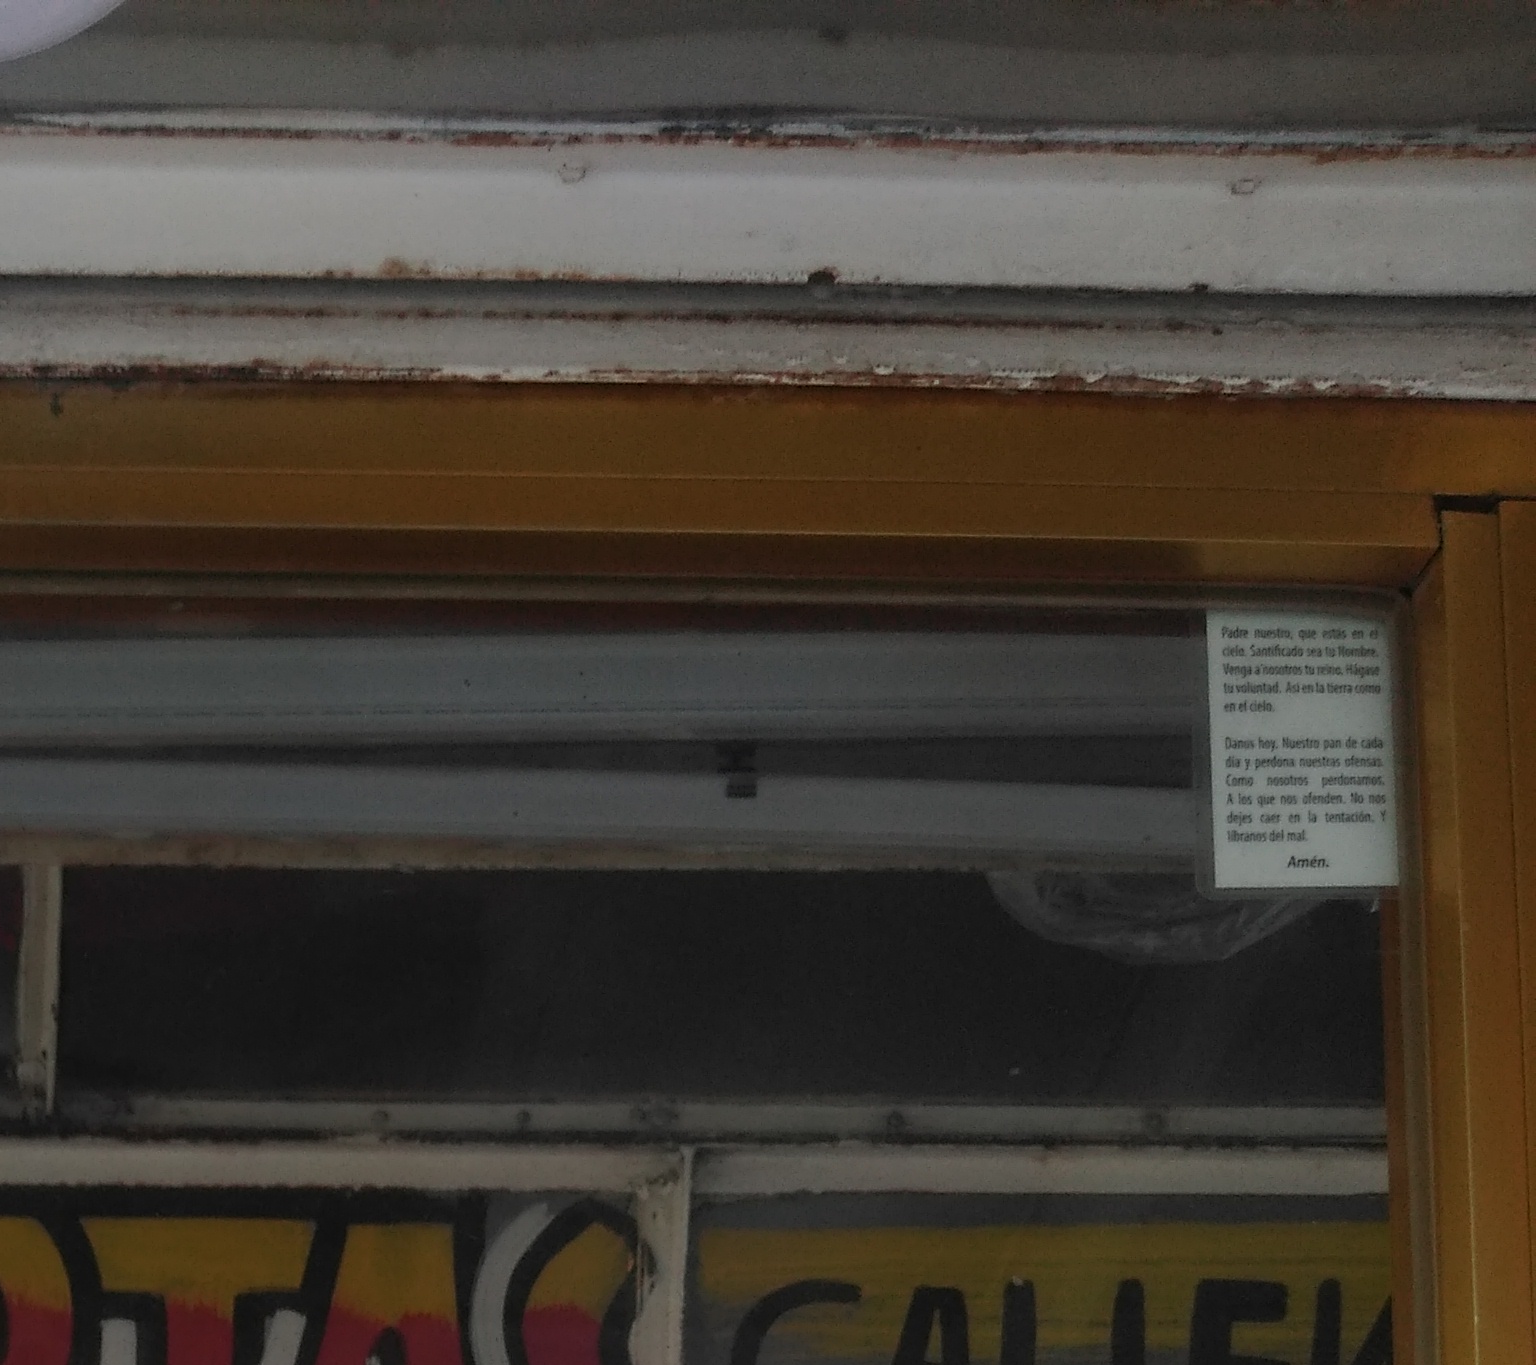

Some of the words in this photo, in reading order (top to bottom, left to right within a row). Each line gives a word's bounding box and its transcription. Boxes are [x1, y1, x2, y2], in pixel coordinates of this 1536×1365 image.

[1221, 626, 1249, 640] Padre
[1253, 627, 1294, 640] nuestro,
[1297, 629, 1317, 641] que
[1351, 629, 1364, 639] en
[1369, 628, 1379, 640] el
[1249, 644, 1304, 658] Santificado
[1305, 647, 1323, 657] sea
[1324, 646, 1336, 658] tu
[1222, 663, 1253, 678] Venga
[1261, 664, 1303, 676] nosotros
[1304, 664, 1316, 676] tu
[1316, 664, 1344, 676] reino.
[1223, 683, 1235, 694] tu
[1235, 681, 1282, 695] voluntad.
[1301, 684, 1315, 694] en
[1315, 682, 1326, 694] la
[1326, 682, 1353, 694] tierra
[1354, 684, 1382, 695] como
[1223, 701, 1236, 713] en
[1237, 700, 1248, 713] el
[1249, 700, 1276, 713] cielo.
[1224, 736, 1255, 749] Danos
[1257, 736, 1279, 753] hoy.
[1281, 736, 1320, 749] Nuestro
[1323, 739, 1342, 752] pan
[1344, 736, 1358, 749] de
[1360, 736, 1384, 749] cada
[1243, 758, 1252, 771] y
[1254, 756, 1295, 770] perdona
[1298, 756, 1341, 768] nuestras
[1225, 774, 1254, 787] Como
[1266, 775, 1309, 787] nosotros
[1320, 773, 1386, 789] perdonamos.
[1226, 793, 1234, 806] A
[1237, 793, 1253, 806] los
[1256, 794, 1276, 808] que
[1279, 794, 1298, 805] nos
[1350, 792, 1365, 805] No
[1367, 793, 1387, 805] nos
[1226, 811, 1253, 827] dejes
[1259, 814, 1281, 825] caer
[1287, 813, 1301, 824] en
[1307, 810, 1318, 824] la
[1379, 810, 1387, 822] Y
[1268, 829, 1285, 842] del
[1286, 855, 1331, 869] Amén.
